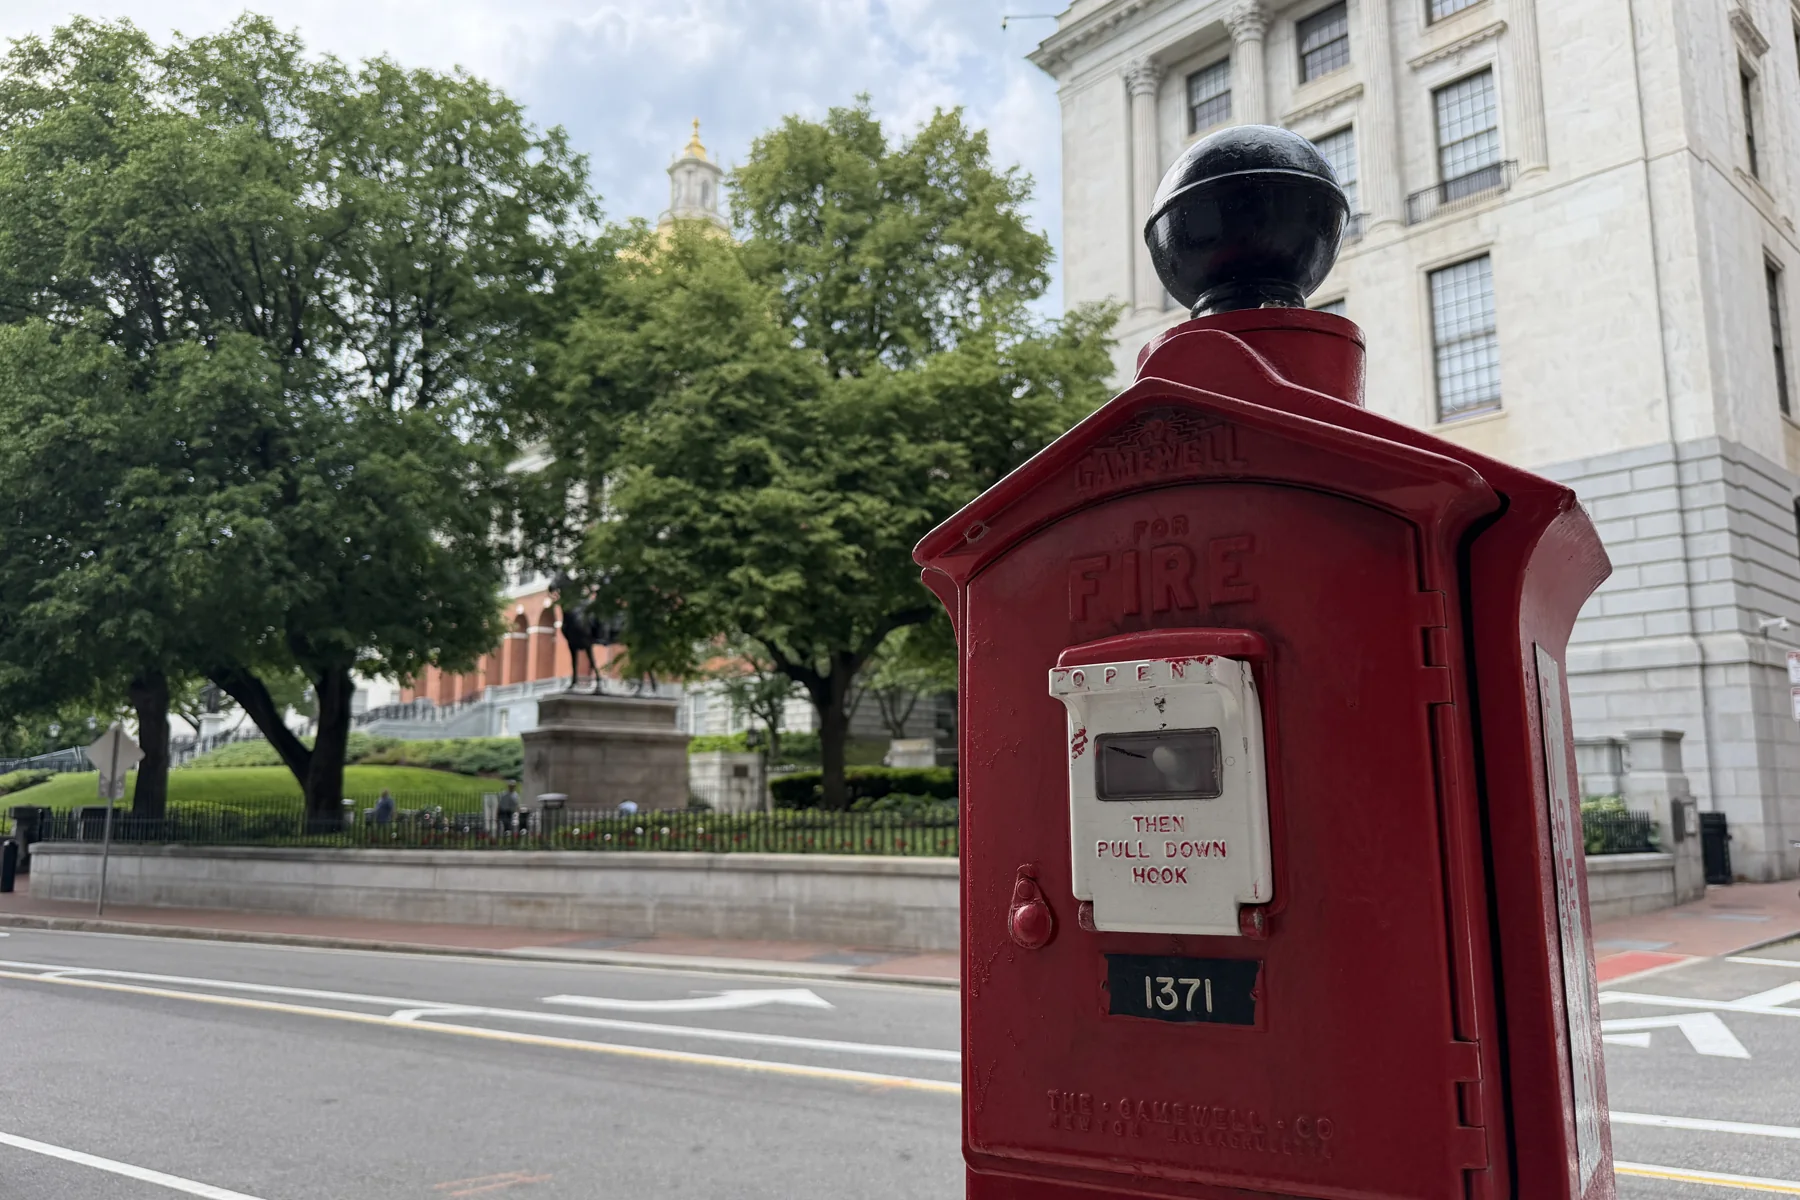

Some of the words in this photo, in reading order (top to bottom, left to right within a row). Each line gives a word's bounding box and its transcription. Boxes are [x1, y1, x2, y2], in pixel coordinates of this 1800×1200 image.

[1074, 423, 1247, 492] GAMEWELL
[1133, 514, 1189, 543] FOR
[1069, 534, 1255, 622] FIRE
[1071, 661, 1187, 688] OPEN
[1132, 815, 1186, 833] THEN
[1096, 840, 1150, 859] PULL
[1165, 840, 1227, 859] DOWN
[1132, 867, 1188, 884] HOOK
[1145, 975, 1213, 1013] 1371
[1047, 1089, 1093, 1115] THE
